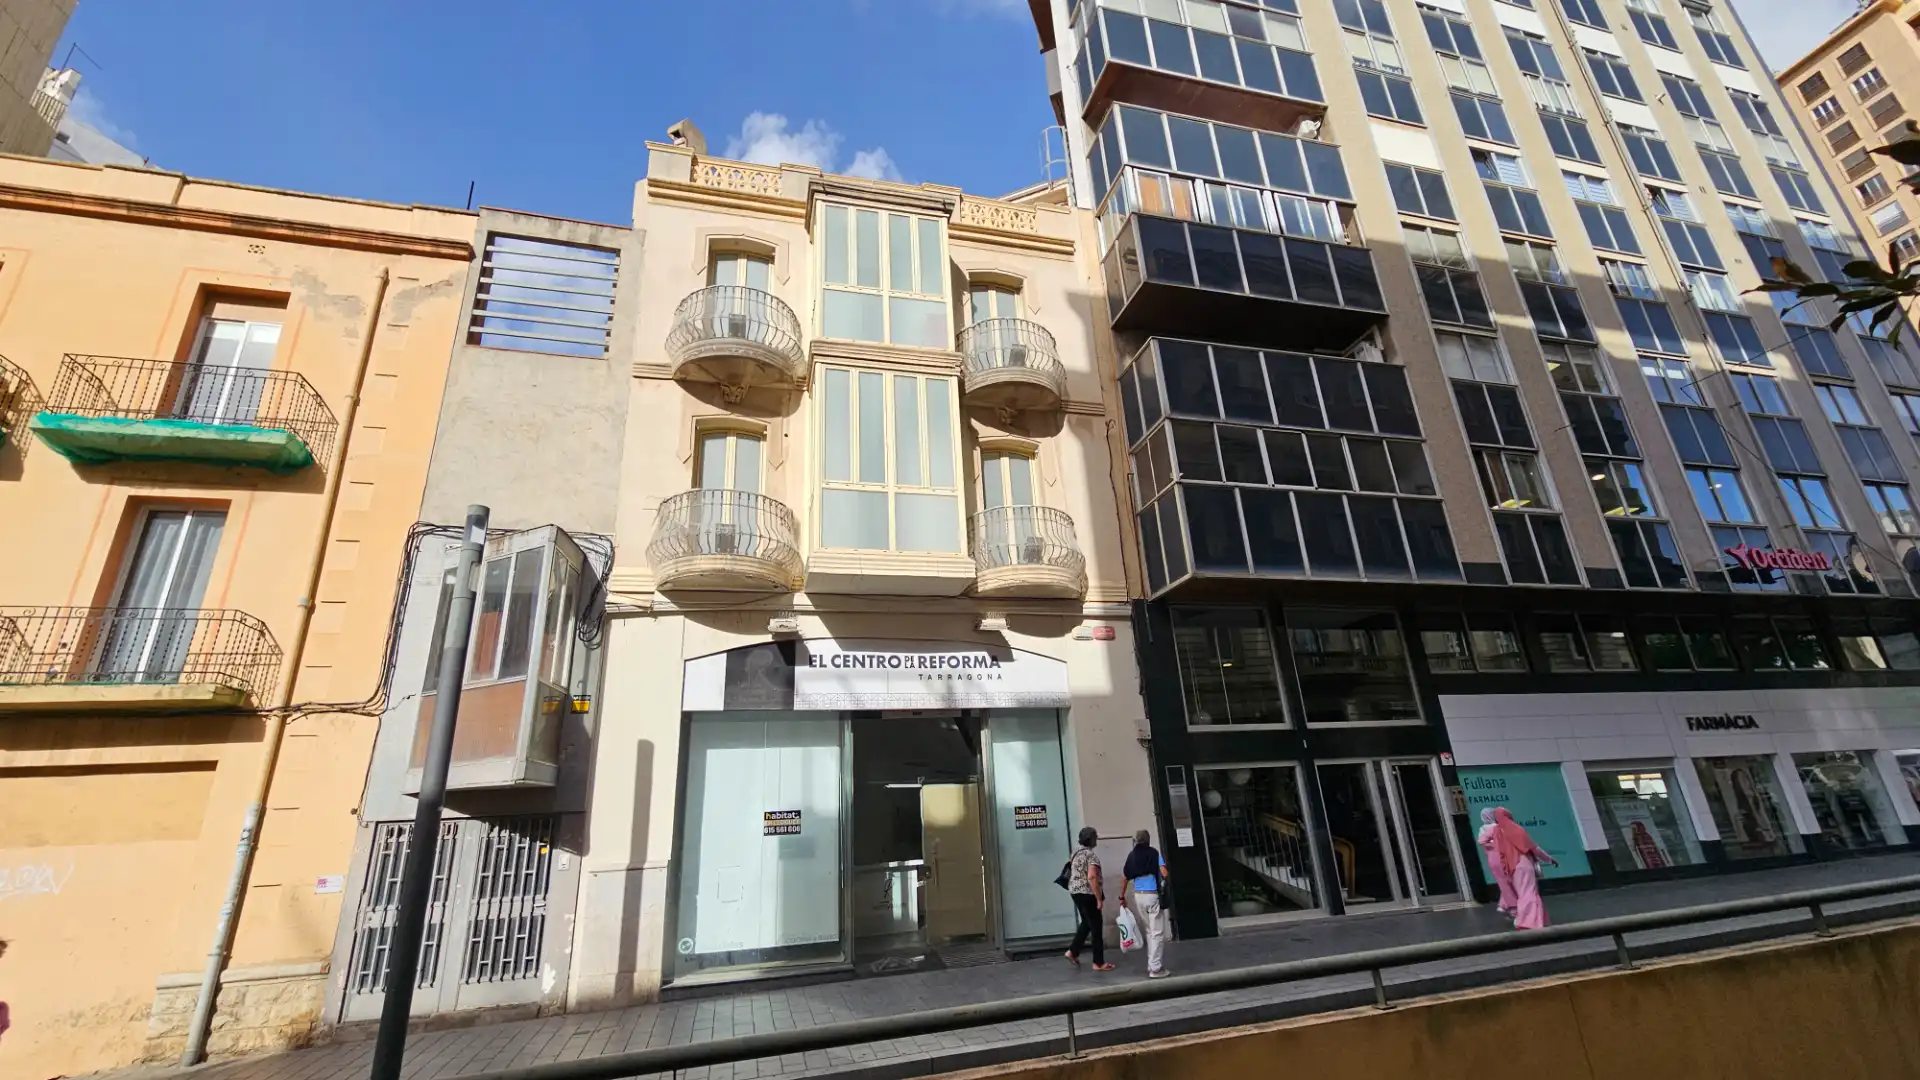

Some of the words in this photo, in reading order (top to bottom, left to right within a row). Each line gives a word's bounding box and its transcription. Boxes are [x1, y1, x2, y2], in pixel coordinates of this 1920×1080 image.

[1748, 547, 1830, 571] Occident
[808, 654, 828, 669] EL
[831, 654, 901, 669] CENTRO
[904, 655, 915, 663] DE
[918, 655, 1002, 669] REFORMA
[918, 673, 1003, 681] TARRAGONA
[1685, 712, 1760, 731] FARMÀCIA
[1463, 777, 1507, 791] Fullana
[765, 812, 797, 820] habitat
